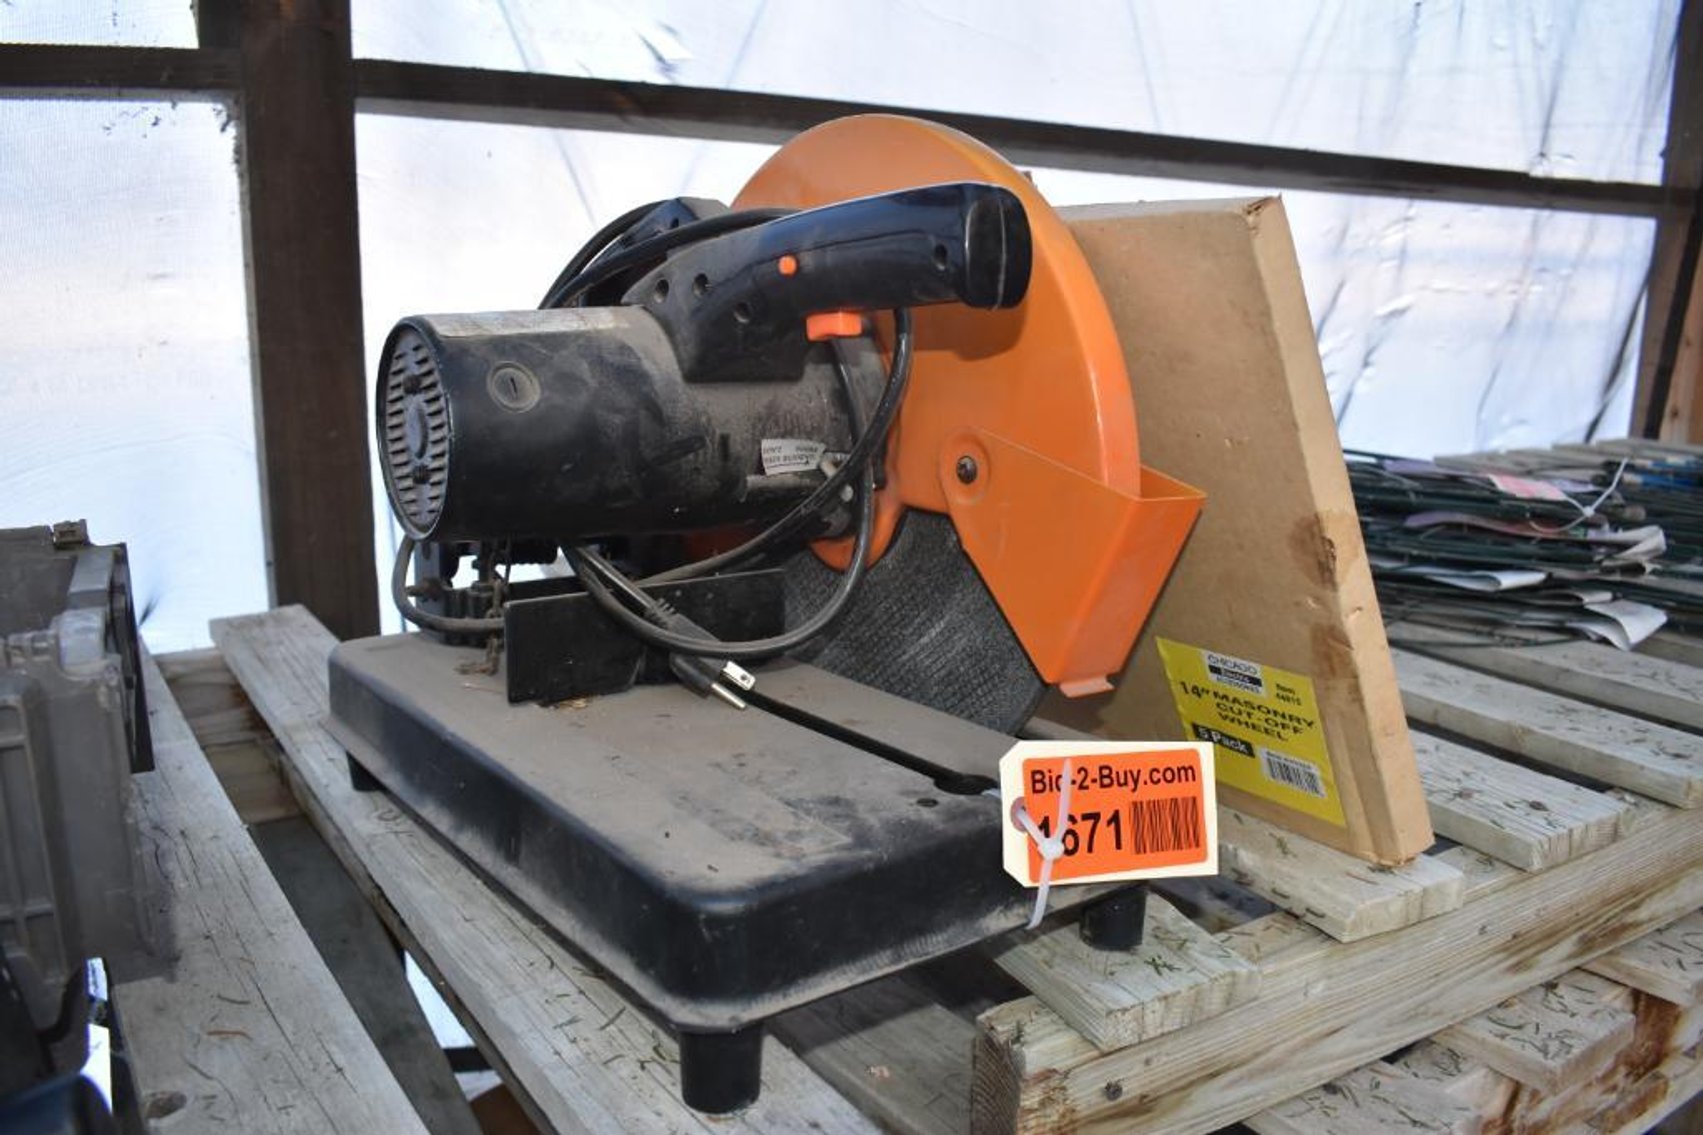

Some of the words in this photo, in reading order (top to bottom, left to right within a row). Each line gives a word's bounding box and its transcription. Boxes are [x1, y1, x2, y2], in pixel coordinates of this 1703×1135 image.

[1180, 681, 1210, 699] 14"
[1212, 691, 1315, 728] MASONRY
[1216, 701, 1304, 736] CUT-OFF
[1211, 731, 1250, 753] Pack
[1217, 712, 1289, 741] WHEEL
[1038, 809, 1122, 857] 1671
